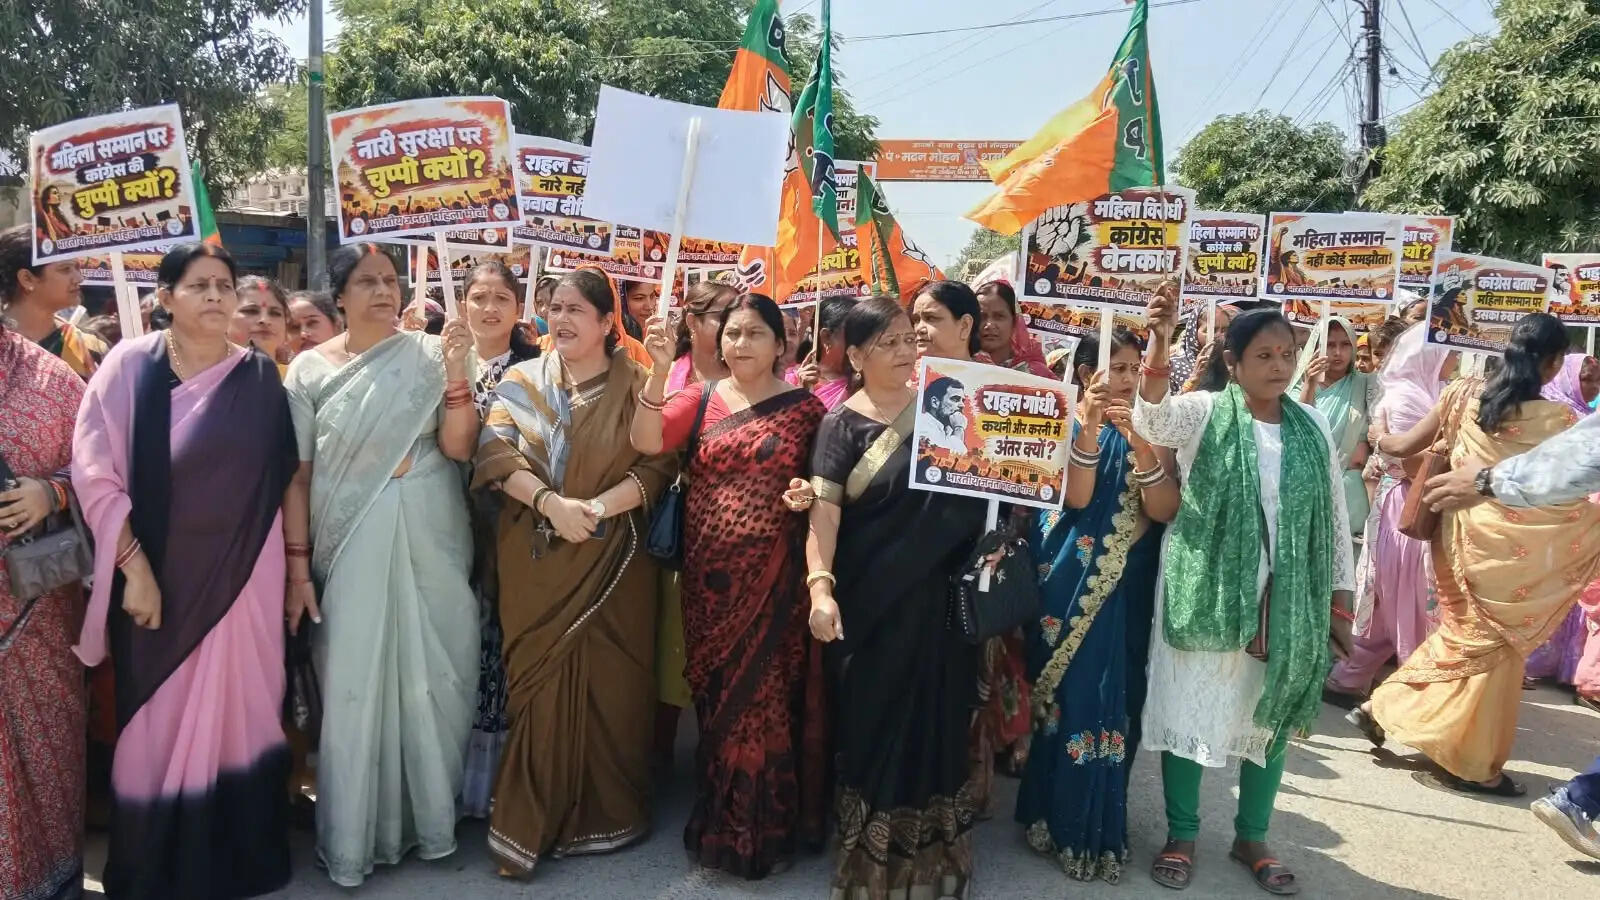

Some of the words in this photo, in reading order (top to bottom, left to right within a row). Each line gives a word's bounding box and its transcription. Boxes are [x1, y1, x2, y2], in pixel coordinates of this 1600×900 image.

[52, 142, 96, 169] महिला
[96, 131, 147, 159] सम्मान
[146, 126, 168, 147] पर
[356, 129, 396, 159] नारी
[397, 127, 455, 157] सुरक्षा
[457, 127, 482, 145] पर
[525, 155, 570, 177] राहुल
[901, 152, 927, 162] मदन
[929, 149, 960, 163] मोहन
[84, 161, 127, 182] कांग्रेस
[127, 156, 145, 173] की
[365, 156, 419, 198] चुप्पी
[540, 176, 563, 192] नारे
[75, 178, 120, 219] चुप्पी
[1094, 195, 1142, 220] महिला
[369, 214, 403, 228] भारतीय
[403, 212, 431, 225] जनता
[431, 208, 462, 221] महिला
[462, 205, 488, 219] मोर्चा
[56, 234, 83, 249] भारतीय
[83, 232, 109, 246] जनता
[110, 228, 140, 241] महिला
[1110, 221, 1167, 245] कांग्रेस
[1191, 223, 1216, 240] हिला
[1217, 226, 1247, 240] सम्मान
[1248, 226, 1259, 240] पर
[1293, 229, 1337, 249] महिला
[1419, 231, 1434, 242] पर
[1206, 241, 1232, 252] कांग्रेस
[1232, 241, 1243, 253] की
[1197, 252, 1225, 275] चुप्पी
[1306, 252, 1325, 267] नहीं
[1326, 251, 1347, 267] कोई
[1478, 272, 1511, 291] कांग्रेस
[1056, 283, 1090, 296] भारतीय
[1090, 287, 1116, 299] जनता
[1116, 288, 1142, 303] महिला
[1477, 292, 1505, 307] महिला
[1505, 295, 1531, 307] सम्मान
[1532, 296, 1543, 308] पर
[1474, 310, 1500, 321] उसका
[983, 390, 1022, 418] राहुल
[1023, 390, 1060, 418] गांधी,
[982, 418, 1012, 434] कथनी
[1013, 419, 1027, 435] और
[1028, 421, 1051, 436] करनी
[1052, 422, 1062, 436] में
[994, 435, 1022, 456] अंतर
[946, 471, 980, 487] भारतीय
[980, 479, 1001, 490] जनता
